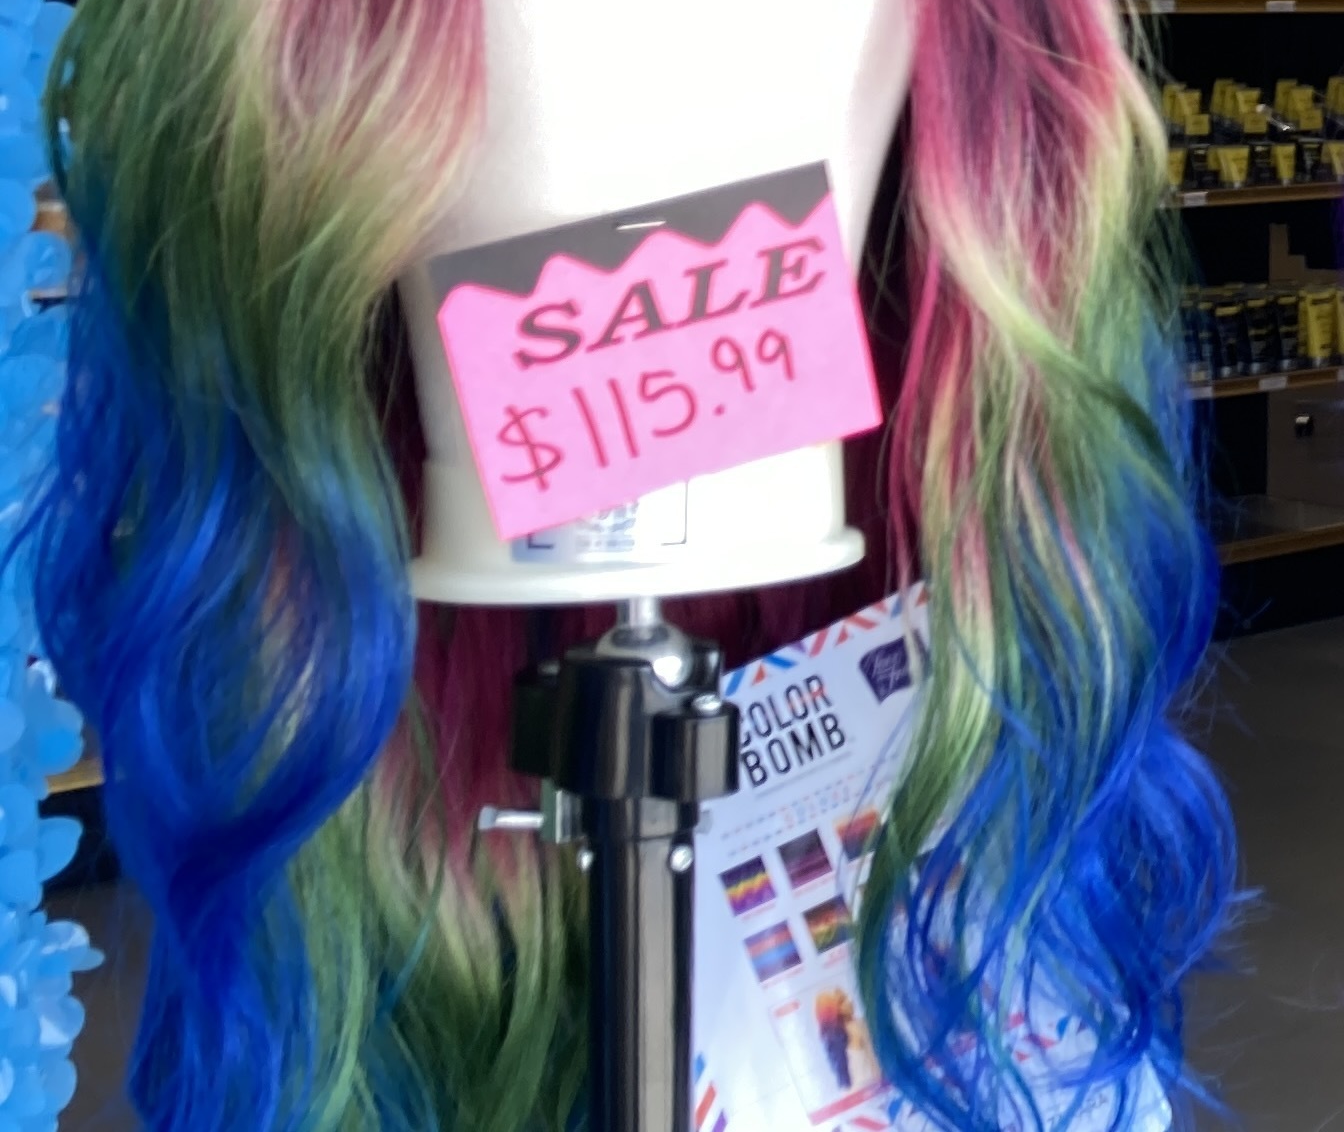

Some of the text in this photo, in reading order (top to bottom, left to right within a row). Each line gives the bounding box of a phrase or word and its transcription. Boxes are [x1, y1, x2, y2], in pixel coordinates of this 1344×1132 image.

[513, 236, 826, 371] SALE
[496, 327, 796, 492] $115.99
[740, 712, 846, 789] BOMB
